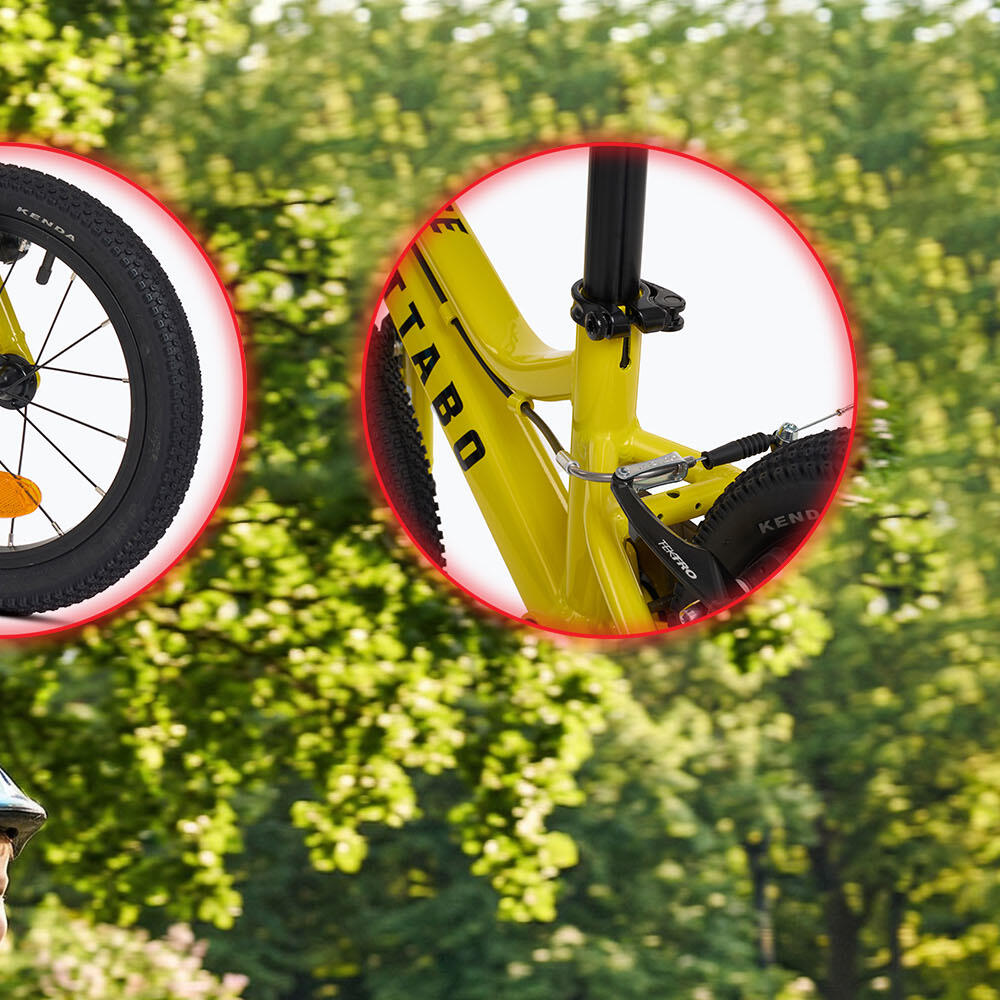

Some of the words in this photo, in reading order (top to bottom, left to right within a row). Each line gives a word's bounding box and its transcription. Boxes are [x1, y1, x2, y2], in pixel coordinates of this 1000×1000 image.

[16, 206, 76, 242] KENDA
[758, 509, 821, 534] KEND
[657, 539, 698, 580] TEKTRO
